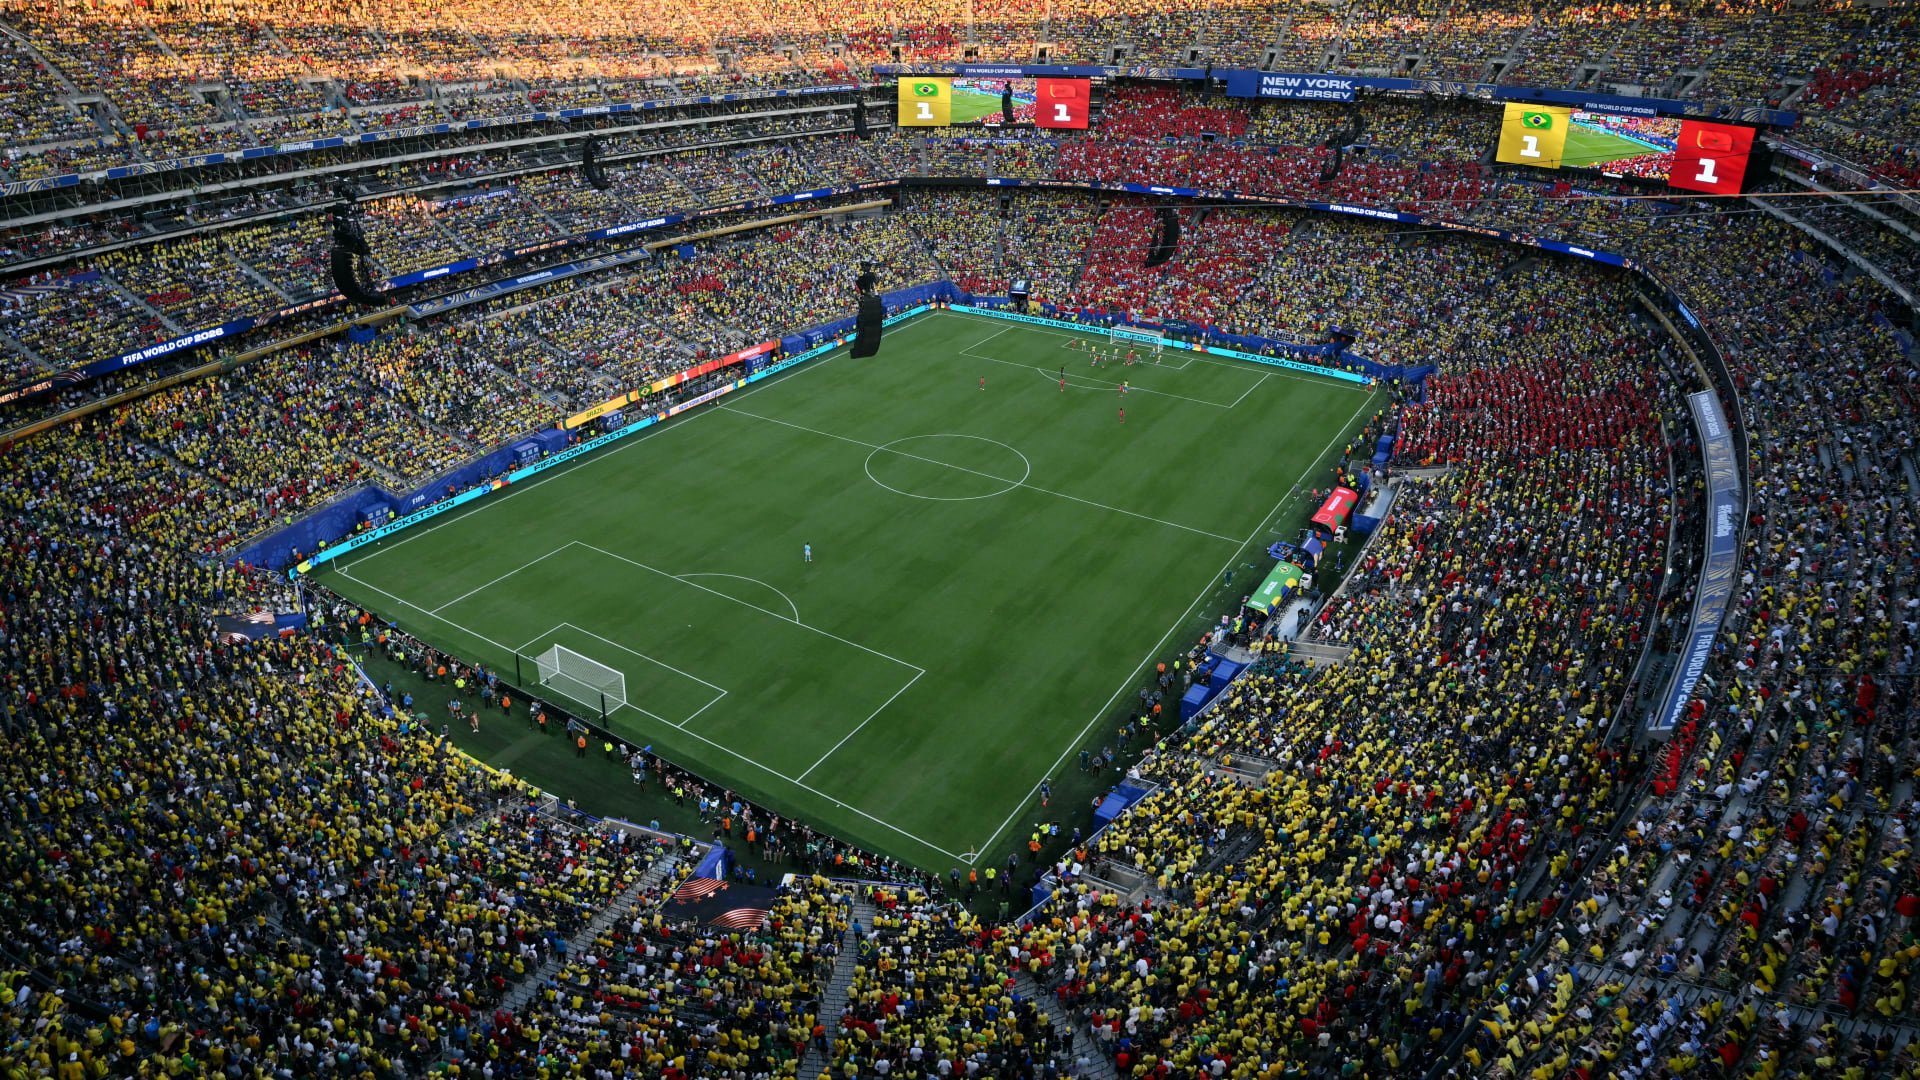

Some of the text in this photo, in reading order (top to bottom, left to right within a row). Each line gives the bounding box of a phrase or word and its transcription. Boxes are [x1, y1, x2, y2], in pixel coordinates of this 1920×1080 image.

[1262, 76, 1352, 90] NEW YORK
[1262, 88, 1351, 99] NEW JERSEY
[916, 102, 934, 119] 1
[1054, 104, 1071, 121] 1
[1520, 136, 1541, 158] 1
[1695, 158, 1718, 184] 1
[618, 224, 636, 233] WORLD
[647, 218, 666, 227] 2026
[968, 308, 1006, 318] WITNESS
[1006, 314, 1043, 324] HISTORY
[1103, 330, 1124, 338] NEW
[1125, 332, 1159, 342] JERSEY
[123, 327, 224, 365] FIFA WORLD CUP 2026
[766, 366, 780, 374] BUY
[782, 353, 808, 367] TICKETS
[1236, 352, 1334, 376] FIFA.COM/TICKETS
[662, 379, 670, 389] 1
[682, 371, 689, 382] 1
[20, 380, 52, 396] JERSEY
[586, 407, 605, 418] BRAZIL
[534, 427, 629, 471] FIFA.COM/TICKETS
[412, 495, 425, 505] FIFA
[350, 499, 455, 547] BUY TICKETS ON
[1696, 634, 1714, 651] FIFA
[1687, 650, 1708, 677] WORLD
[1681, 677, 1698, 693] CUP
